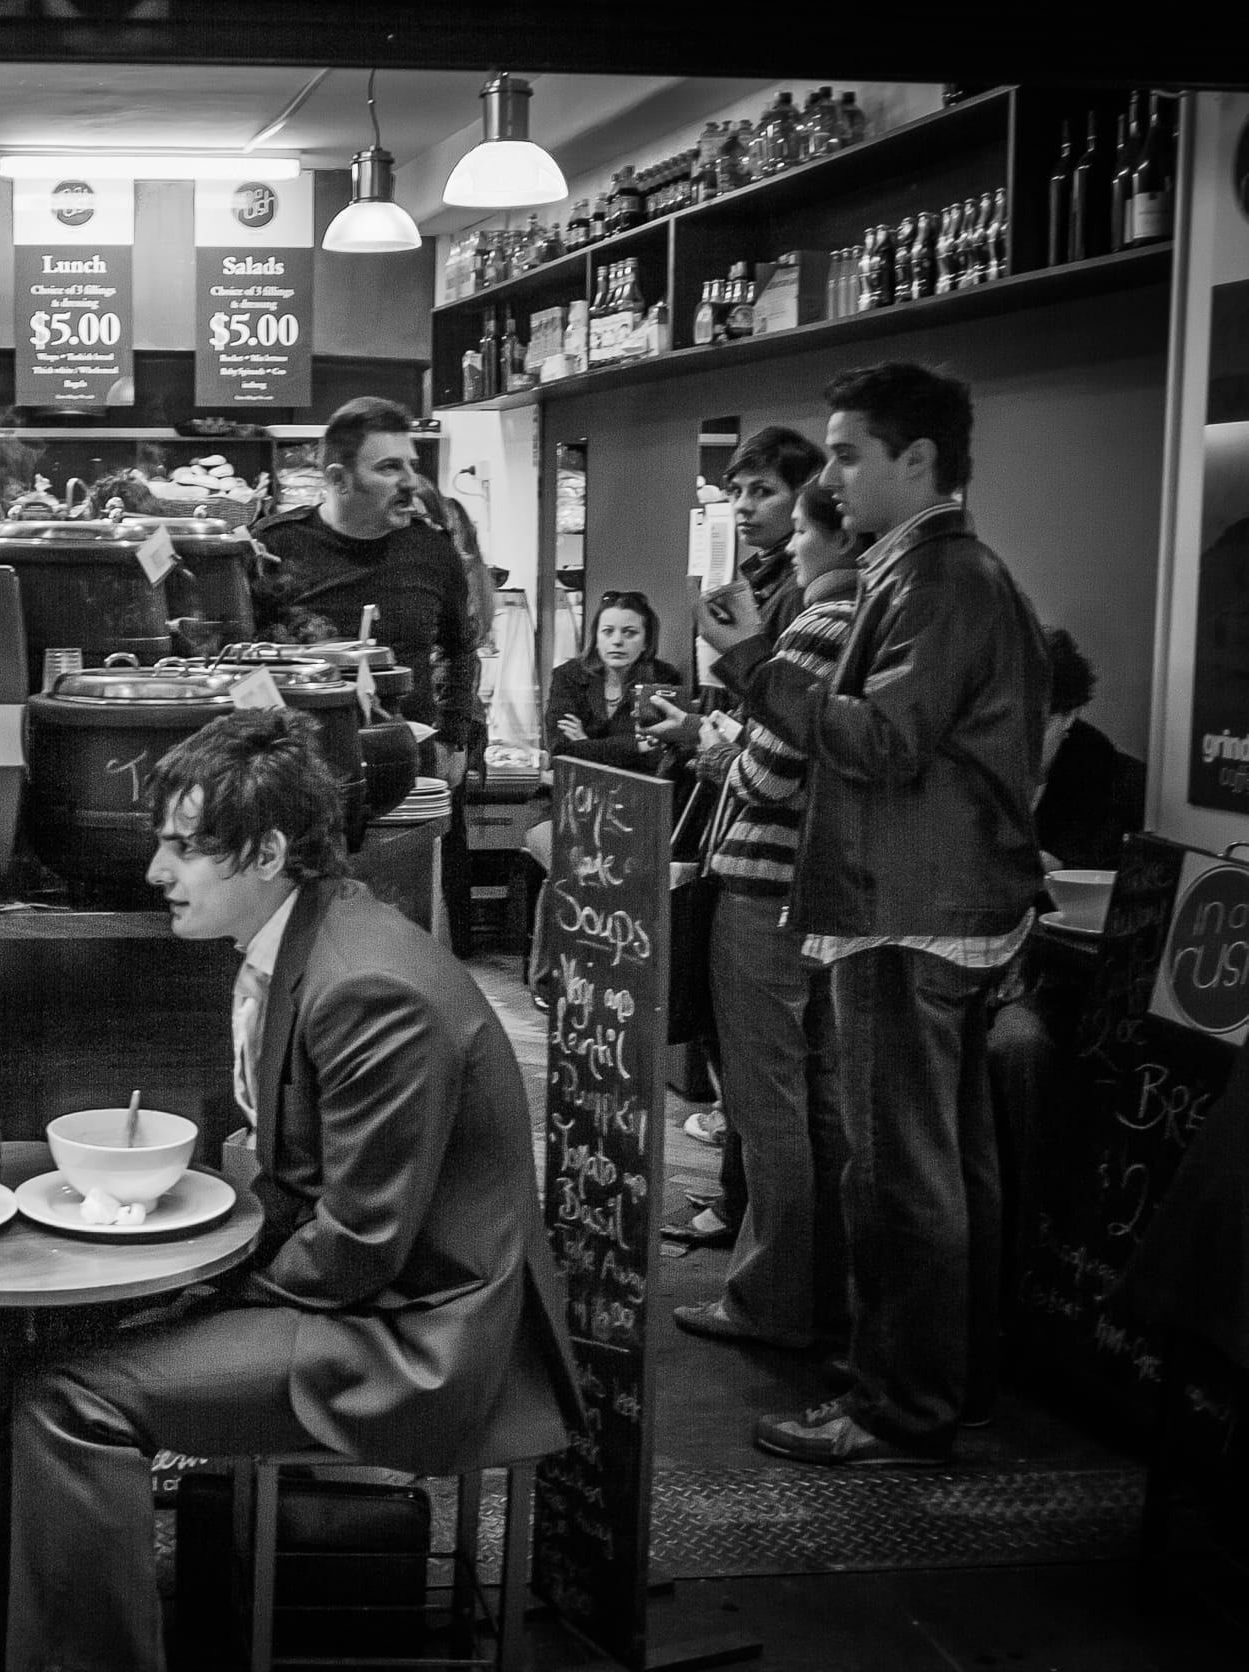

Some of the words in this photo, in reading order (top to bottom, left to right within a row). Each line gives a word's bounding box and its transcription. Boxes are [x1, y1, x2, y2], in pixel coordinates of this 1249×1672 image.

[41, 255, 107, 274] Lunch
[222, 257, 285, 275] Salads
[29, 311, 121, 350] $5.00
[209, 312, 300, 351] $5.00
